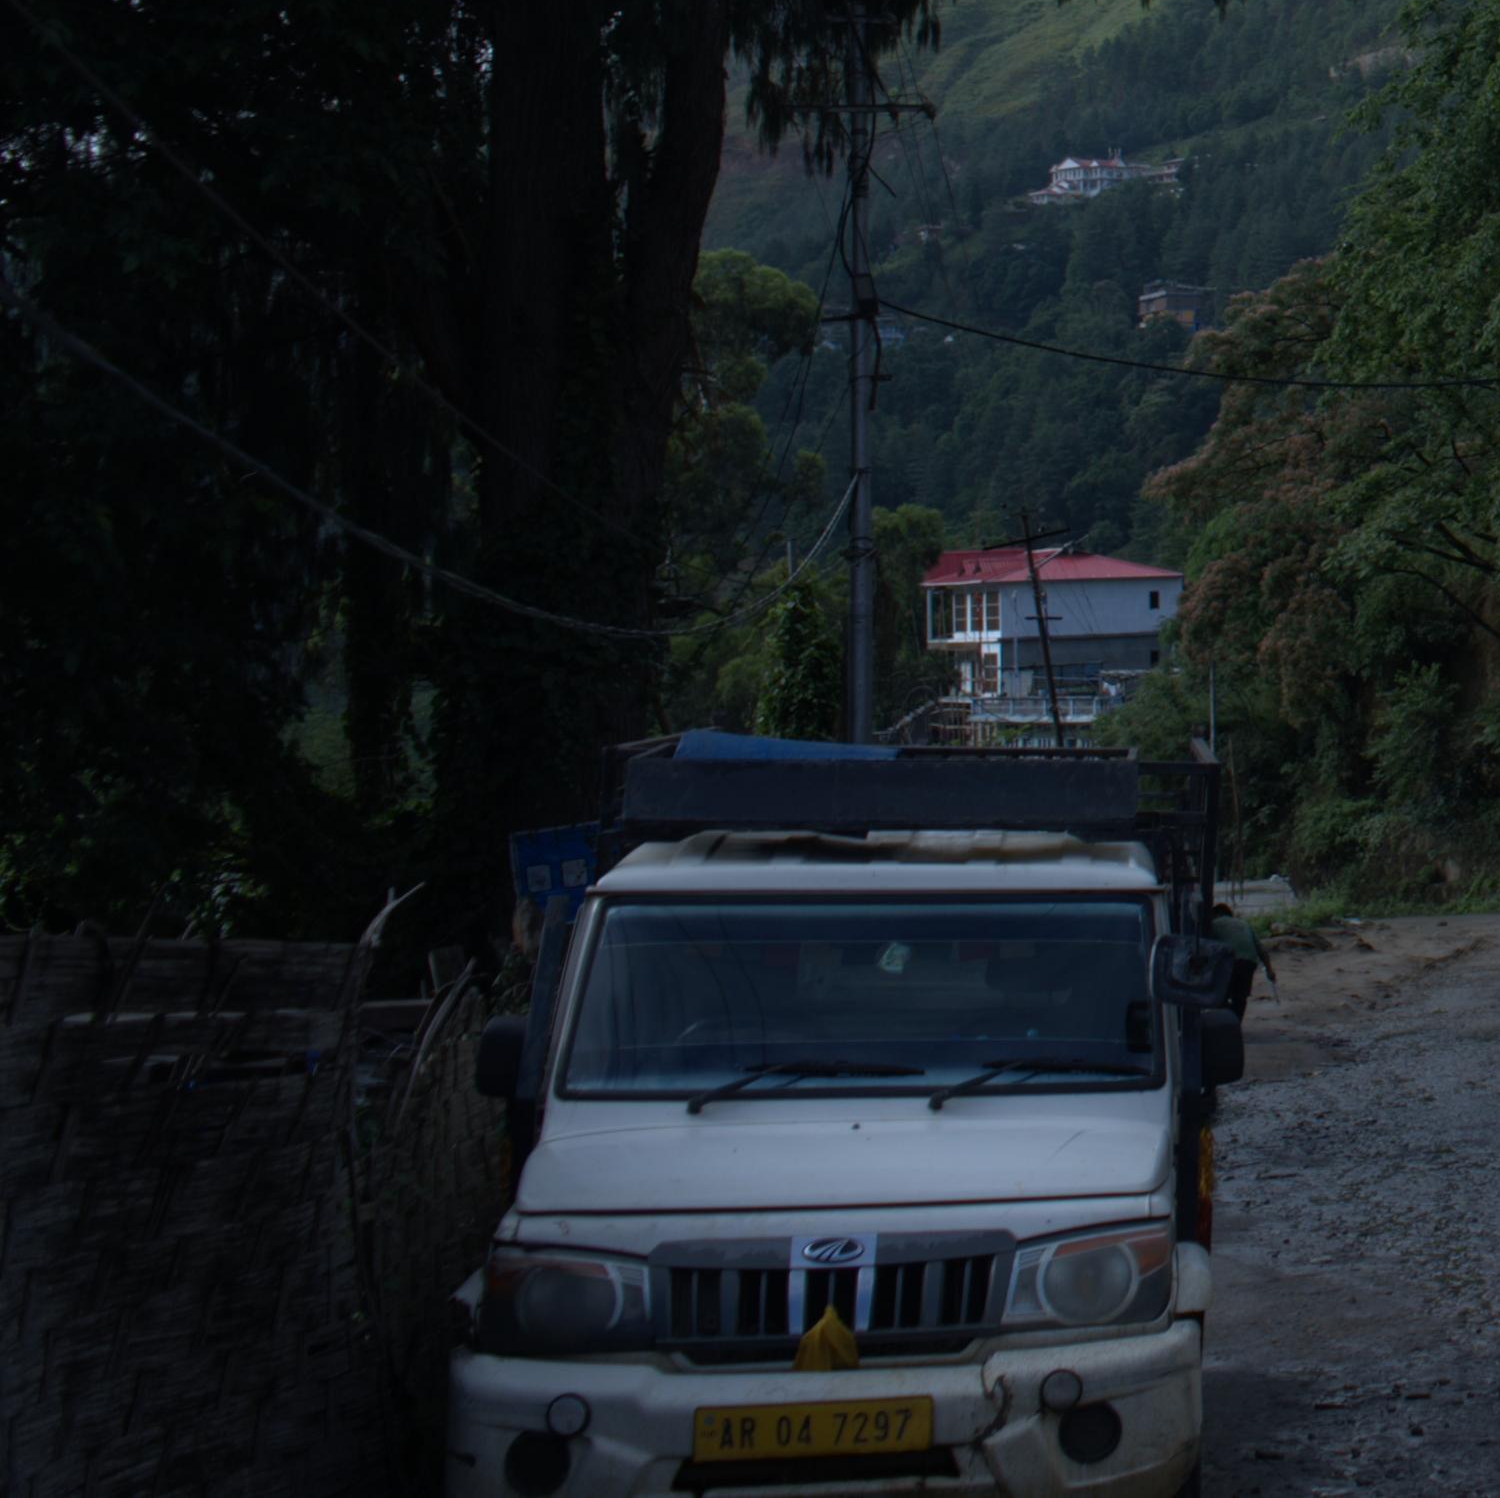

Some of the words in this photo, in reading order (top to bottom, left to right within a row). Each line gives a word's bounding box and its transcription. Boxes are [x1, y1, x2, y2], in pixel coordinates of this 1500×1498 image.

[720, 1416, 756, 1450] AR
[776, 1413, 813, 1447] 04
[832, 1407, 912, 1446] 7297
